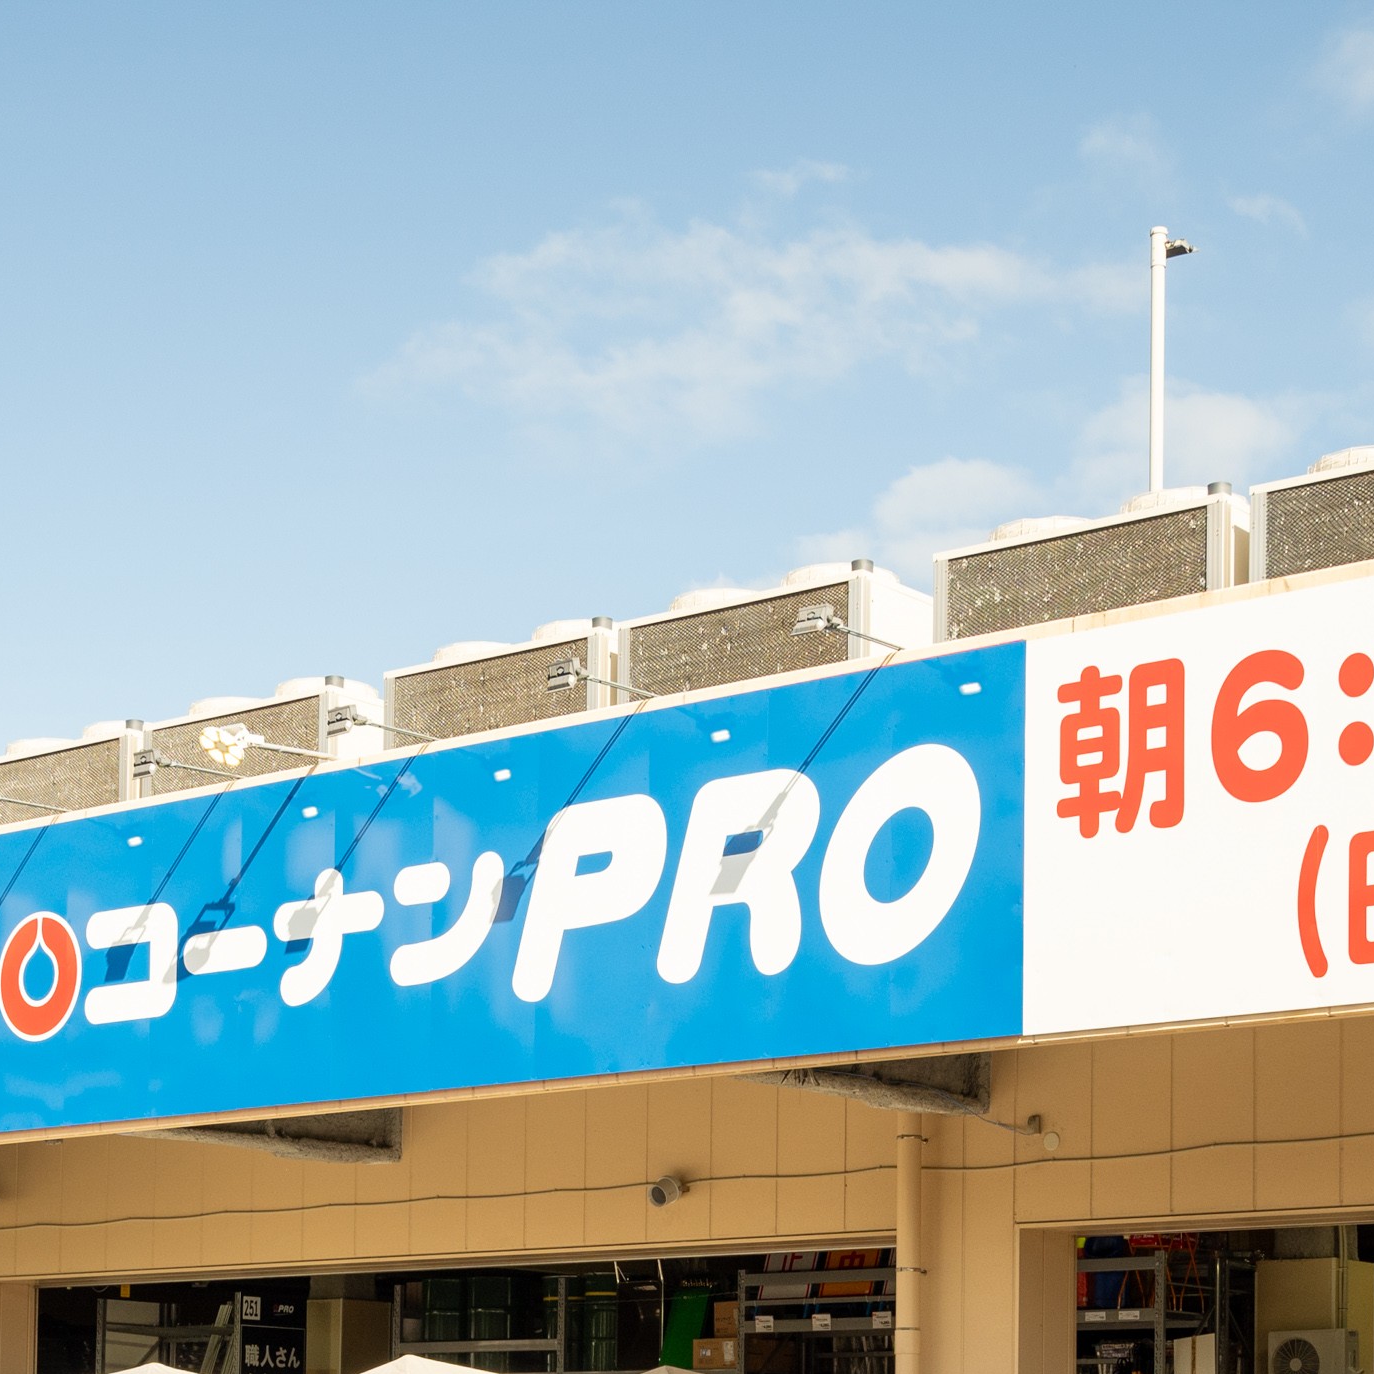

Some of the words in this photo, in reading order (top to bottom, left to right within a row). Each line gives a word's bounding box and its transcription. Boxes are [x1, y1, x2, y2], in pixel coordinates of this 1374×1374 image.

[244, 1300, 259, 1317] 251
[278, 1304, 295, 1314] PRO
[245, 1344, 301, 1369] 職人さん
